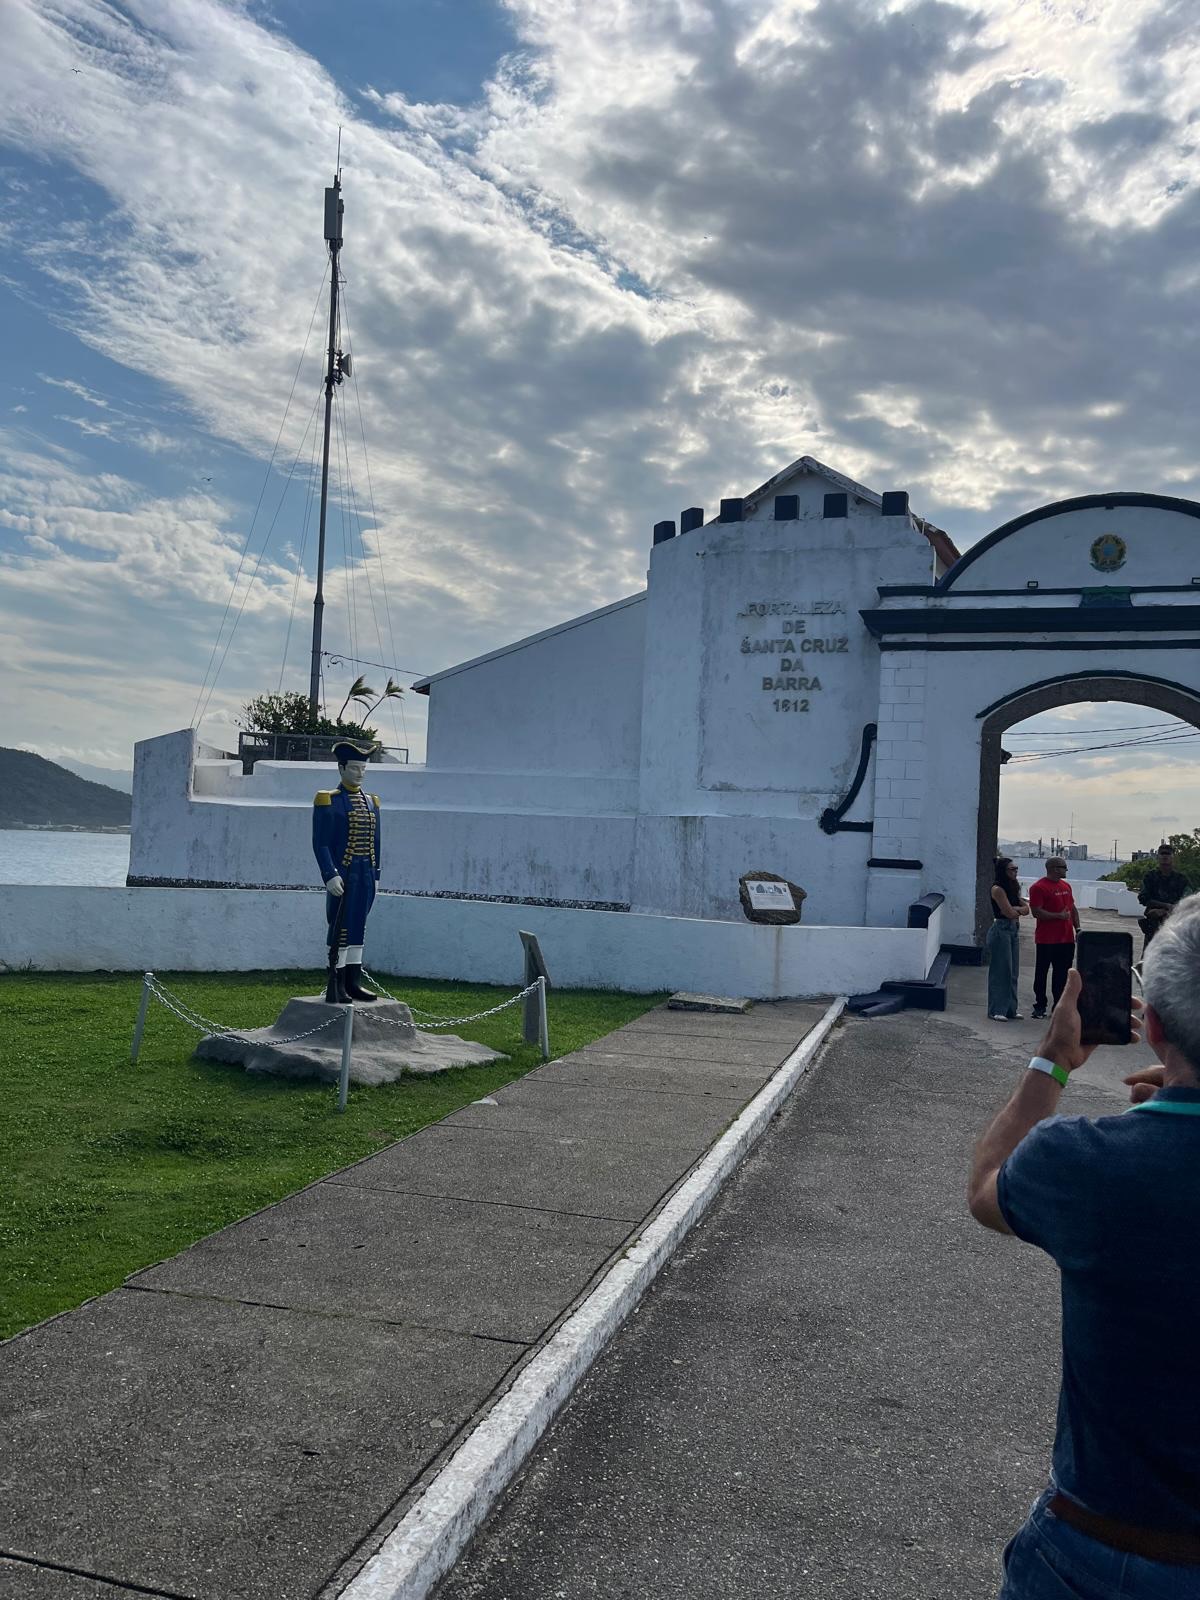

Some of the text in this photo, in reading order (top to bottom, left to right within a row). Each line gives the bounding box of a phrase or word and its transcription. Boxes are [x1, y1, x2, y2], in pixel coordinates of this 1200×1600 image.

[782, 619, 806, 634] DE
[740, 638, 849, 654] SANTA CRUZ
[780, 658, 804, 672] DA
[762, 676, 823, 691] BARRA
[773, 699, 809, 713] 1612
